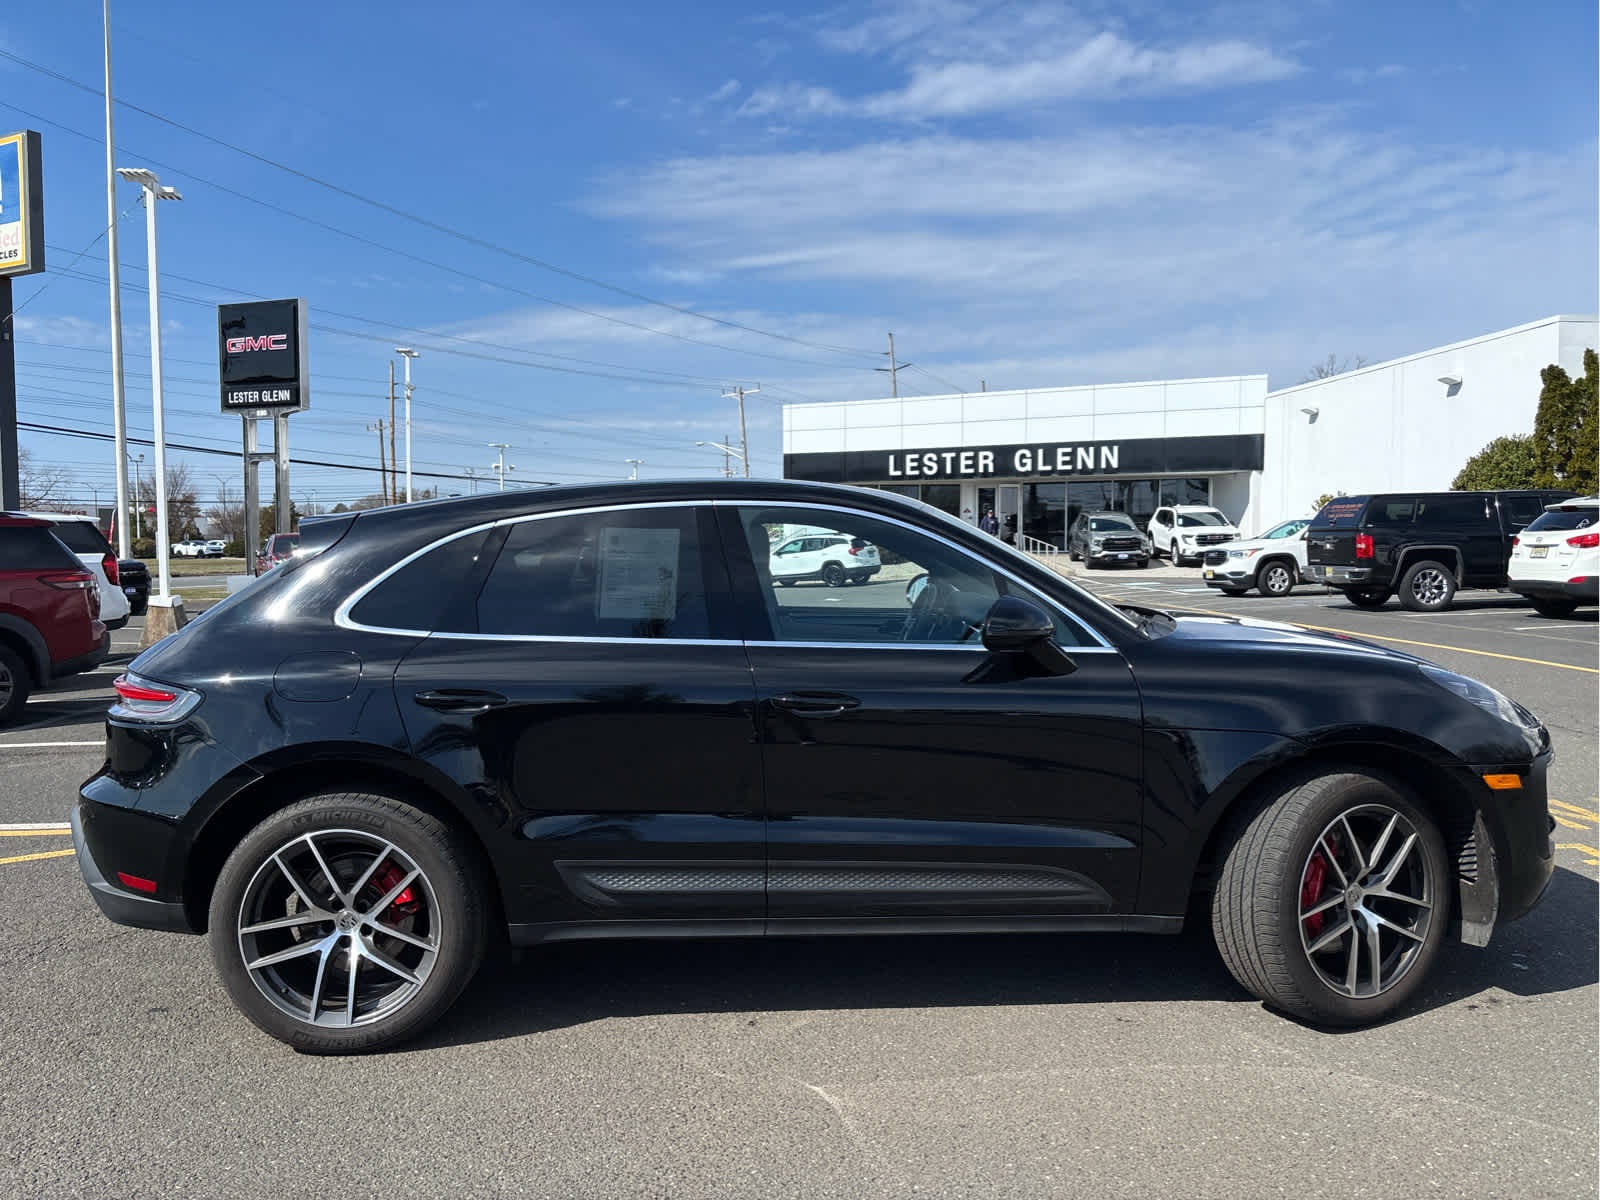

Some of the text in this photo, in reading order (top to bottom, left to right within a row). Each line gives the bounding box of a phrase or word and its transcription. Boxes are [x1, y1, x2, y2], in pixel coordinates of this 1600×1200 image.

[226, 334, 287, 353] GMC
[228, 389, 290, 404] LESTER GLENN
[888, 446, 1119, 476] LESTER GLENN
